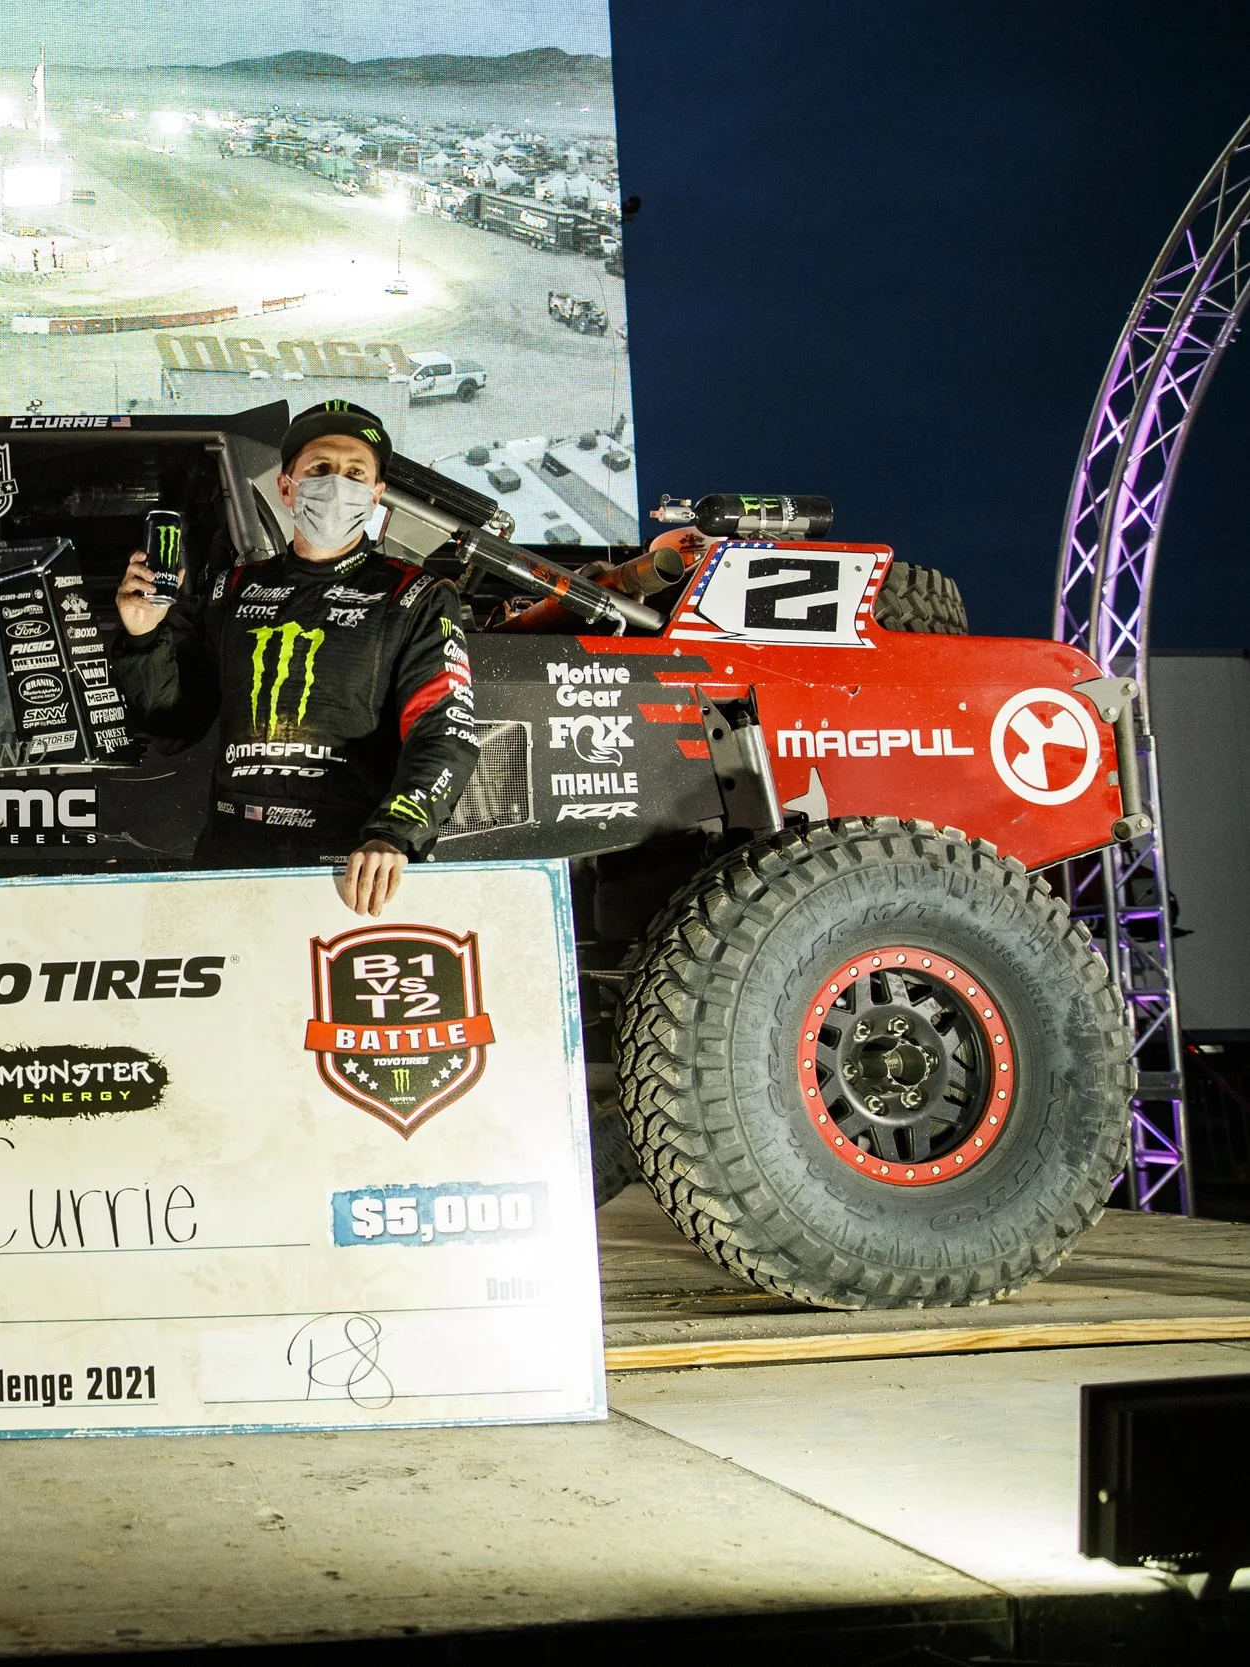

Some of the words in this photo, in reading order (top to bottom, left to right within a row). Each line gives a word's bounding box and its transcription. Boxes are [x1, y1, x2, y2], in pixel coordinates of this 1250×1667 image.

[9, 416, 109, 429] C.CURRIE
[240, 583, 296, 599] CURRIE
[399, 575, 434, 608] sparco
[744, 558, 840, 632] 2
[237, 605, 279, 616] KMC
[326, 607, 369, 628] FOX
[14, 623, 42, 636] Ford
[75, 627, 97, 638] BOXO
[9, 640, 55, 655] RIGID
[71, 643, 104, 655] PROGRESSIVE
[14, 656, 57, 667] METHOD
[82, 667, 105, 680] WARN
[546, 662, 630, 686] Motive
[25, 678, 55, 691] BRANIK
[87, 691, 115, 702] MBRP
[555, 685, 621, 708] Gear
[93, 727, 127, 748] FOREST
[105, 738, 128, 753] RIVER
[548, 714, 635, 767] FOX
[777, 728, 974, 758] MAGPUL
[235, 741, 344, 763] MAGPUL
[231, 764, 326, 778] NITTO
[550, 772, 638, 797] MAHLE
[266, 806, 312, 818] CASEY
[555, 801, 639, 822] RZR
[265, 816, 317, 828] CURRIE
[353, 954, 435, 980] B1
[39, 956, 226, 1003] TIRES
[366, 976, 428, 994] VS
[355, 993, 441, 1019] T2
[335, 1023, 467, 1050] BATTLE
[23, 1090, 131, 1104] ENERGY
[351, 1193, 534, 1243] $5,000
[86, 1364, 157, 1401] 2021
